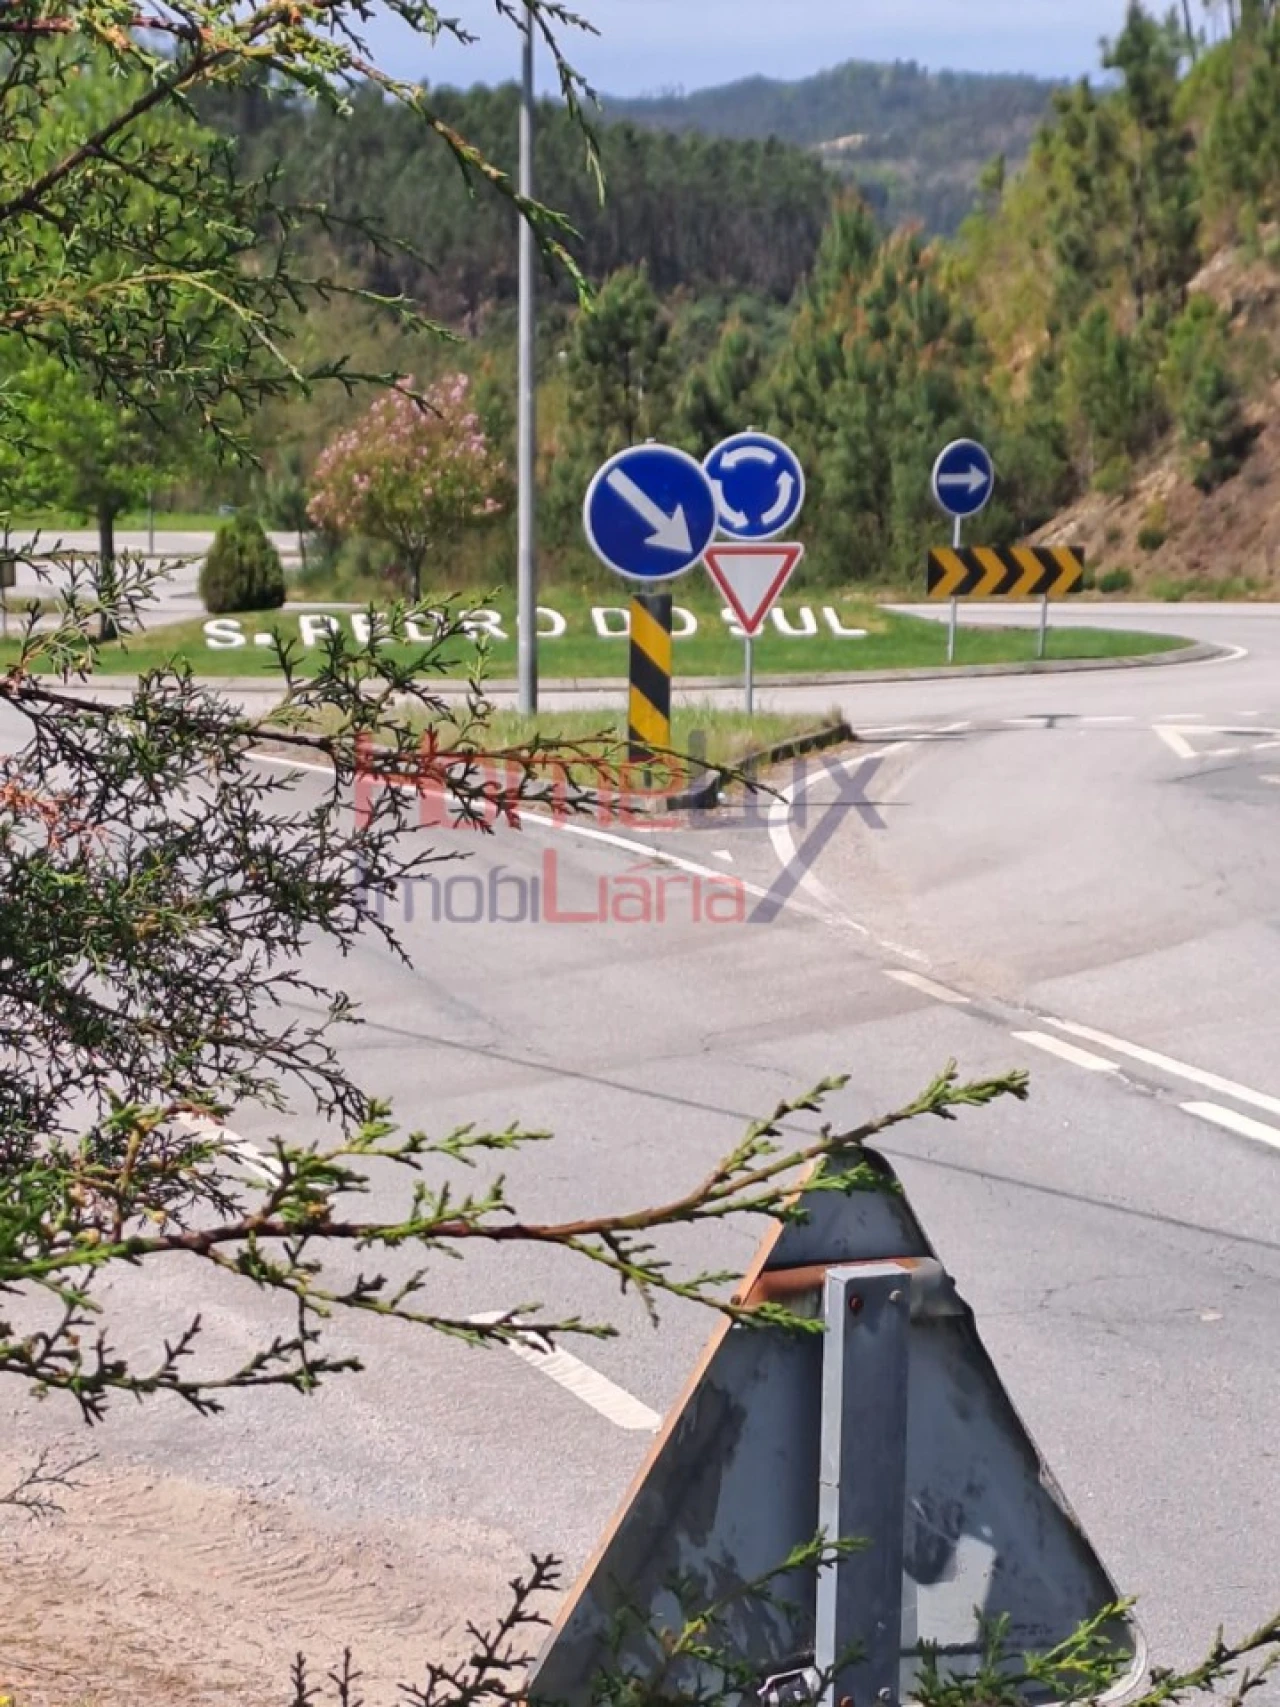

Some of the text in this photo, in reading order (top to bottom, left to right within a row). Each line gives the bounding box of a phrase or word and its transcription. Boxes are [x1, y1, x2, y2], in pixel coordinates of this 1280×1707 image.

[299, 606, 567, 646] PEDRO
[591, 607, 698, 636] DO
[721, 606, 868, 637] SUL
